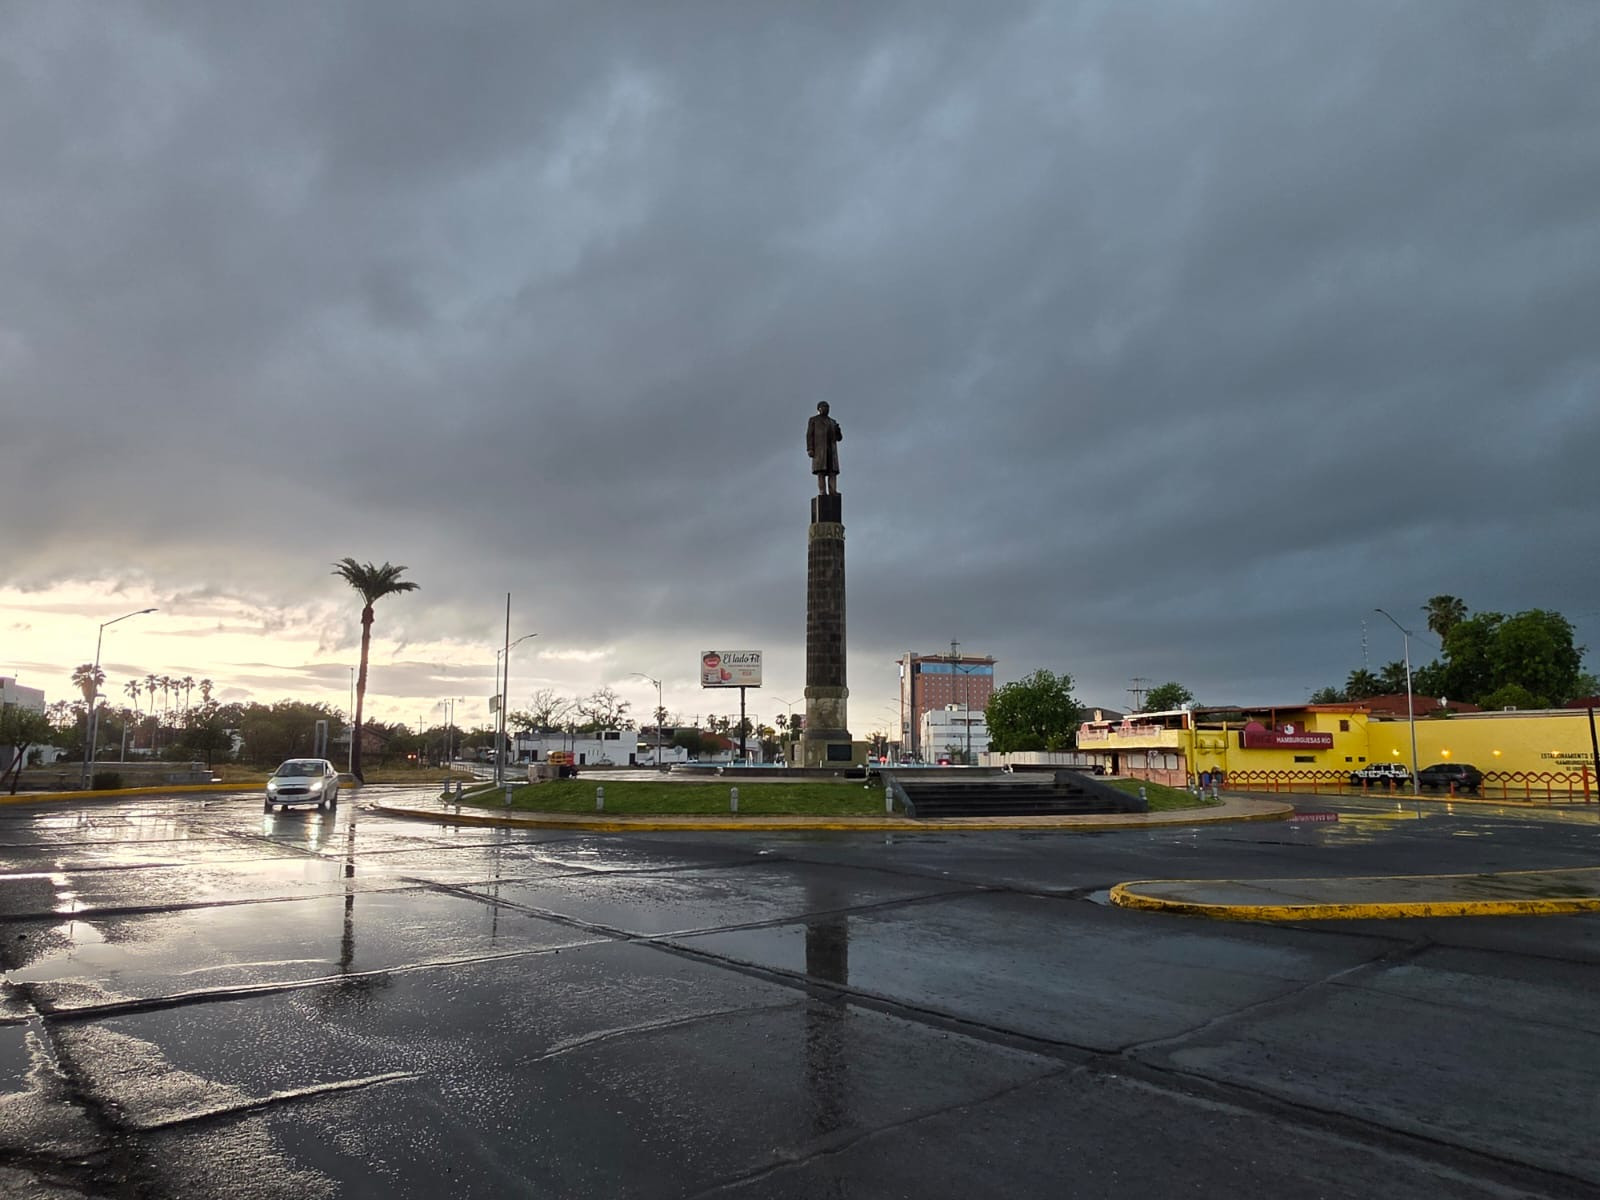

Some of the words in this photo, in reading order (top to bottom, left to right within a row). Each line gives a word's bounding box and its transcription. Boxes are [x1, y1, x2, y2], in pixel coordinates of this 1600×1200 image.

[723, 653, 730, 664] El
[733, 653, 749, 663] lado
[749, 653, 760, 663] Fit
[1276, 736, 1320, 744] HAMBURGUESAS
